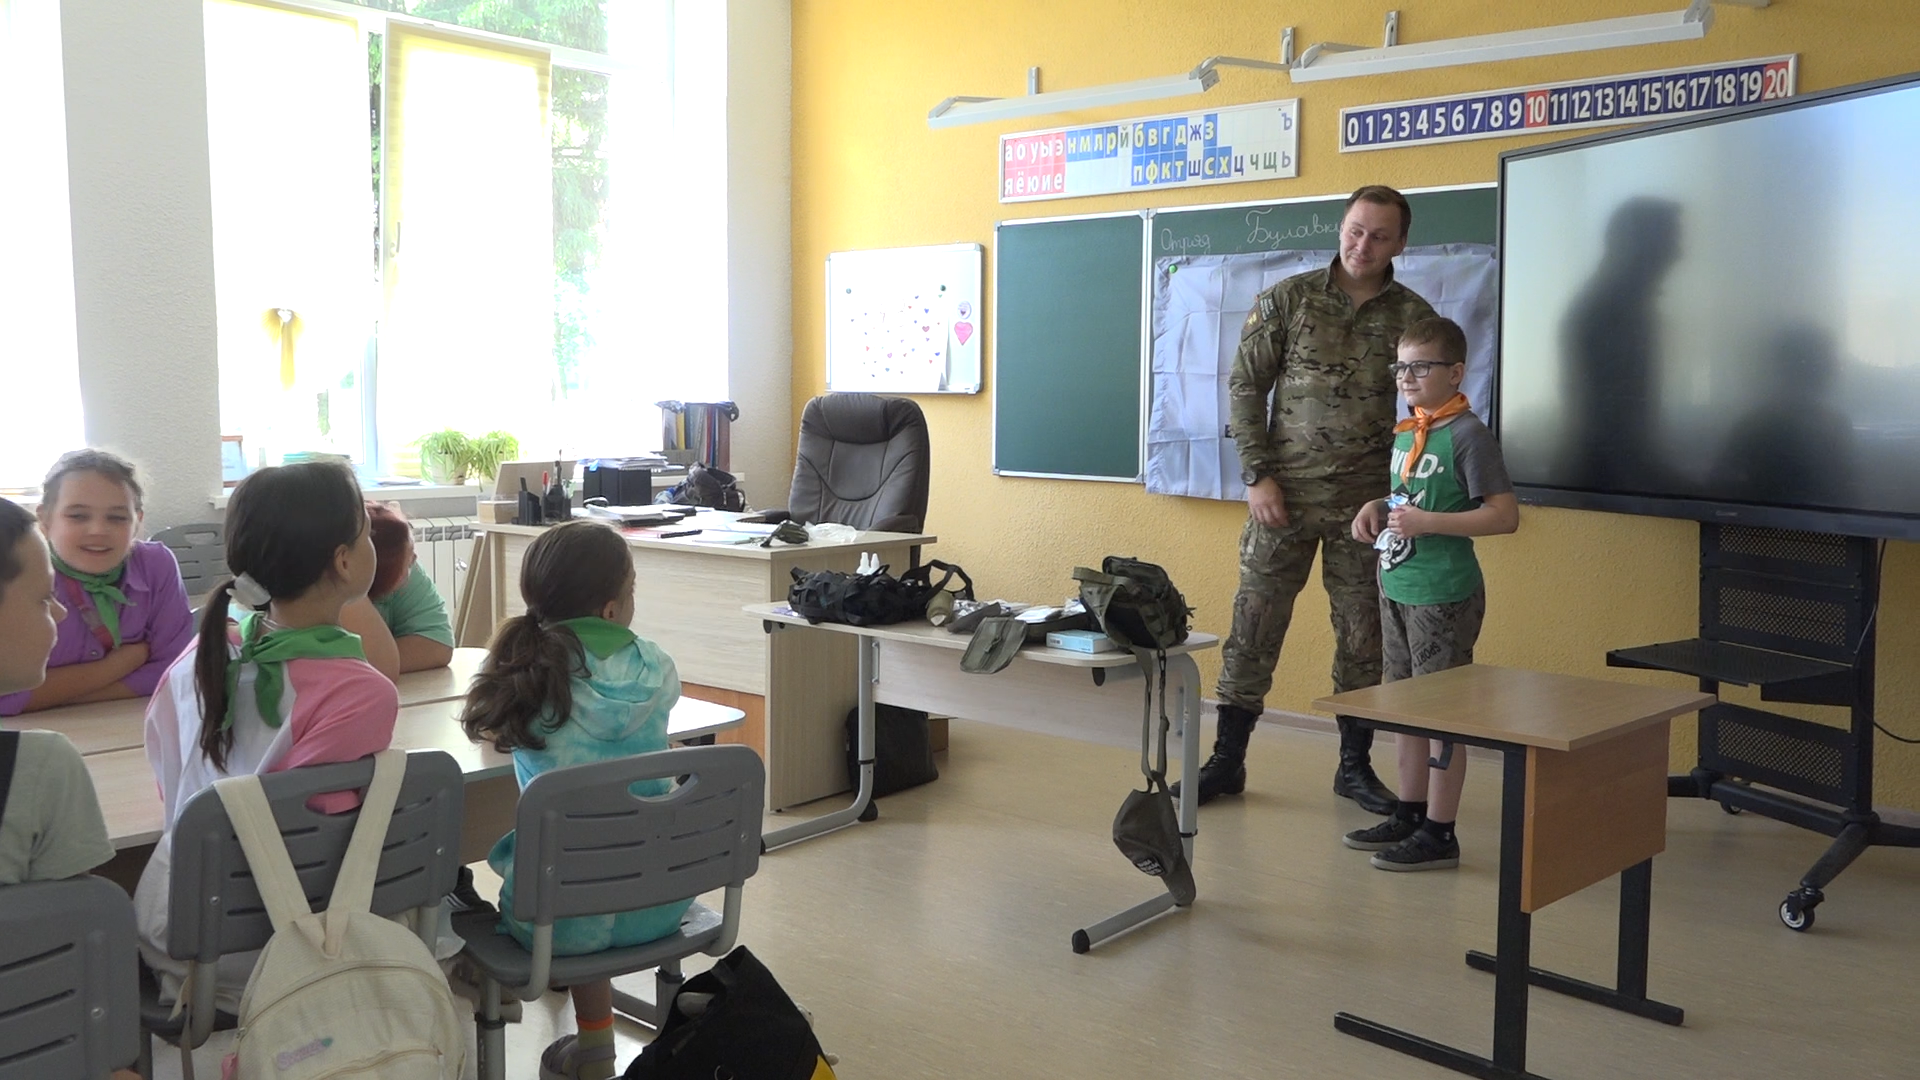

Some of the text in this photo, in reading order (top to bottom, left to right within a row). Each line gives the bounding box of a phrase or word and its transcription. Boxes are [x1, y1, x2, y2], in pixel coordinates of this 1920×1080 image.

[1347, 68, 1788, 143] 0 1 2 3 4 5 6 7 8 9 10 11 12 13 14 15 16 17 18 19 20
